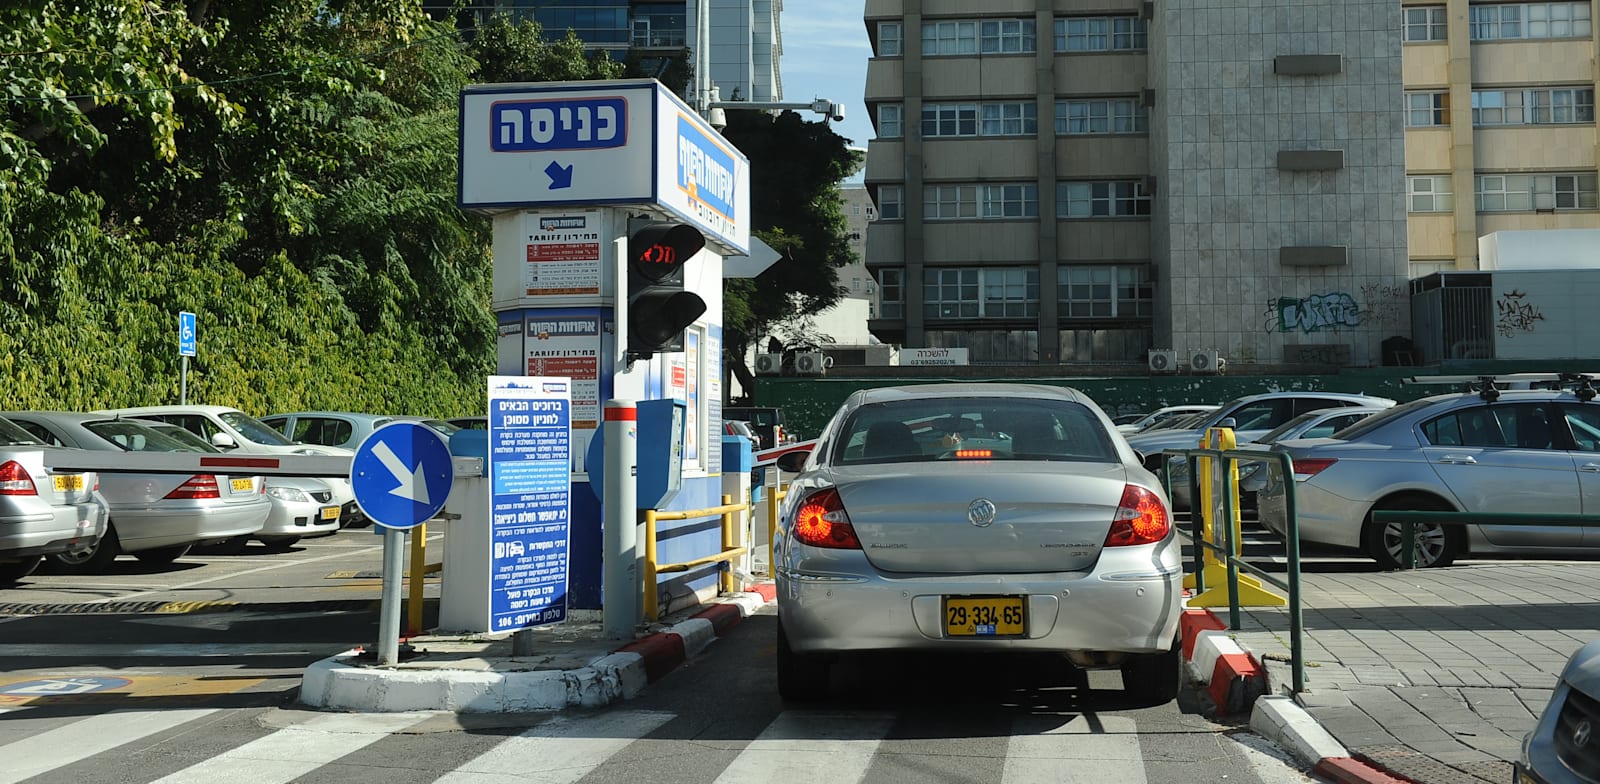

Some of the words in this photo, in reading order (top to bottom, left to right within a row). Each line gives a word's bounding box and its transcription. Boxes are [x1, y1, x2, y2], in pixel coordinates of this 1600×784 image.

[500, 106, 616, 144] כניסה
[640, 244, 676, 264] מלא
[530, 322, 558, 335] החוף
[558, 321, 596, 332] אחוזות
[917, 348, 948, 358] להשכרה
[499, 402, 528, 411] הבאים
[533, 402, 562, 411] ברוכים
[533, 413, 558, 426] לחניון
[518, 511, 536, 523] תשלום
[538, 510, 558, 521] יתאפשר
[559, 508, 566, 519] לא
[495, 514, 516, 525] ביציאה!
[529, 541, 553, 551] התקשרות
[507, 591, 521, 599] פועל
[523, 588, 540, 598] הבקרה
[510, 600, 528, 609] ביממה
[530, 598, 544, 607] שעות
[515, 612, 540, 625] בחירום:
[544, 608, 560, 622] טלפון
[498, 617, 512, 627] 106
